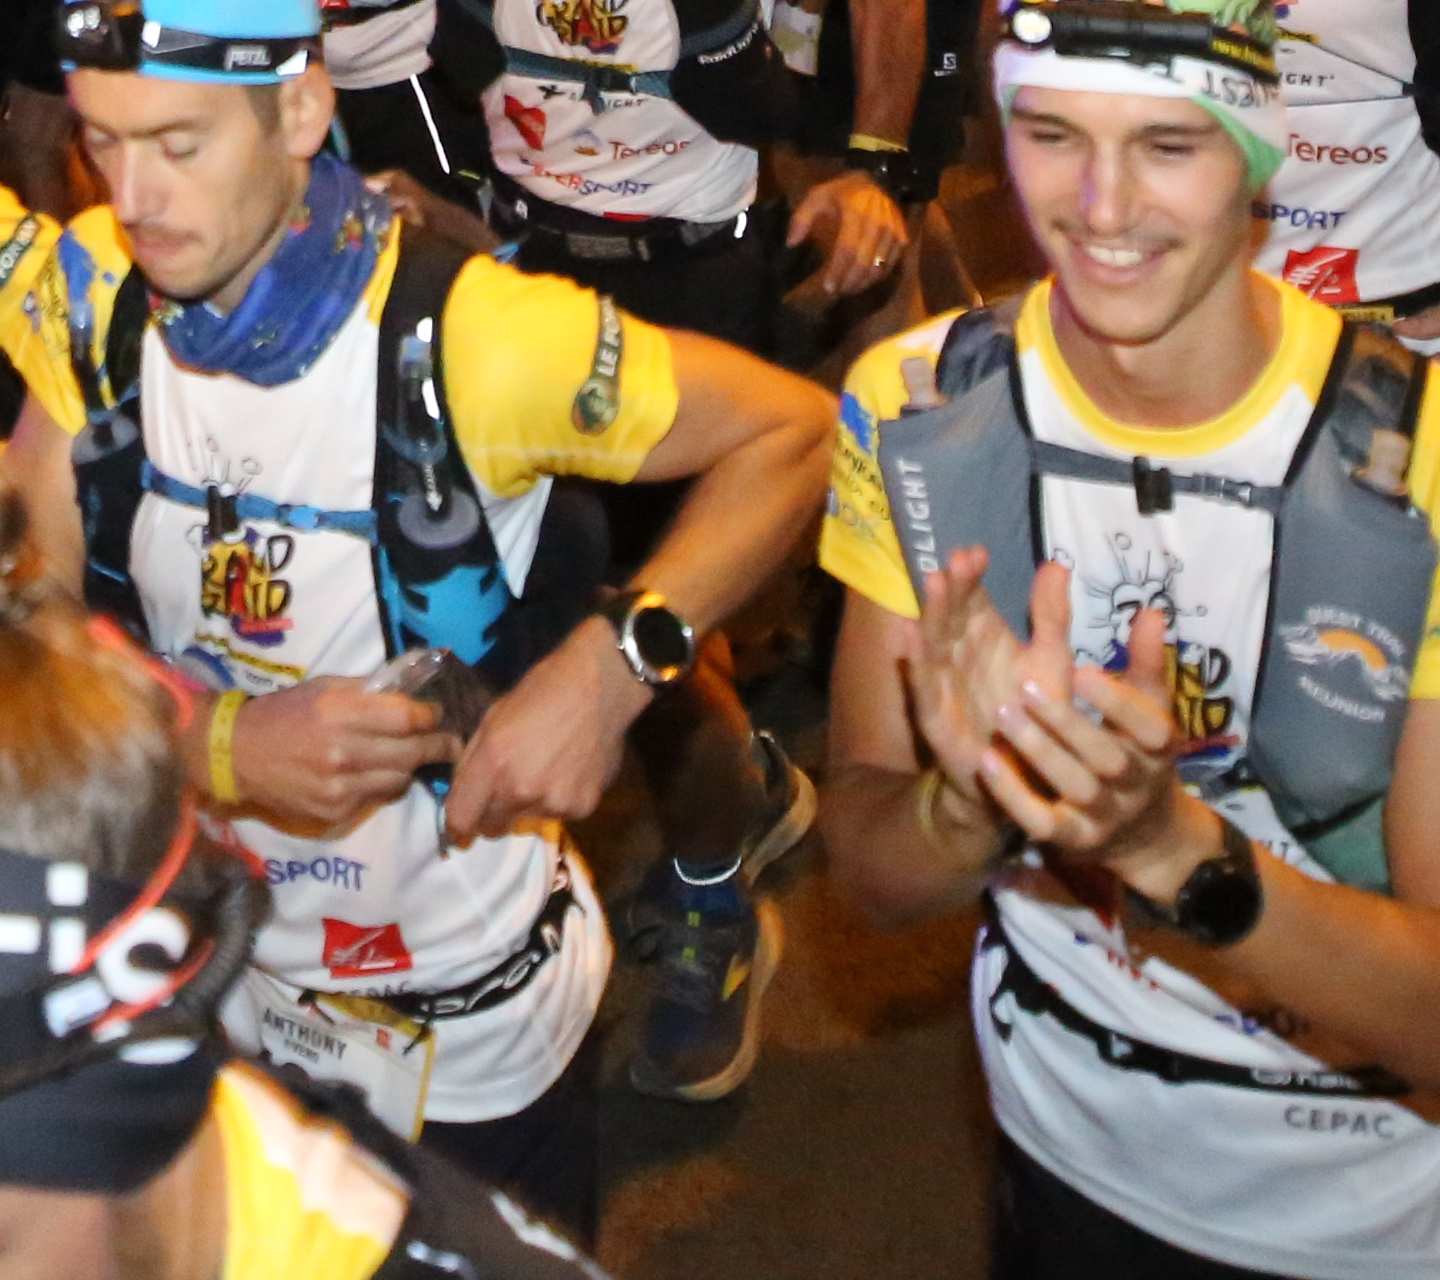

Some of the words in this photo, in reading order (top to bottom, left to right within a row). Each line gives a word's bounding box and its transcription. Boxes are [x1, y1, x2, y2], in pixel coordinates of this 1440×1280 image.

[1286, 134, 1388, 165] Tereos
[265, 856, 365, 893] SPORT
[263, 1008, 347, 1061] ANTHONY
[1283, 1104, 1397, 1140] CEPAC
